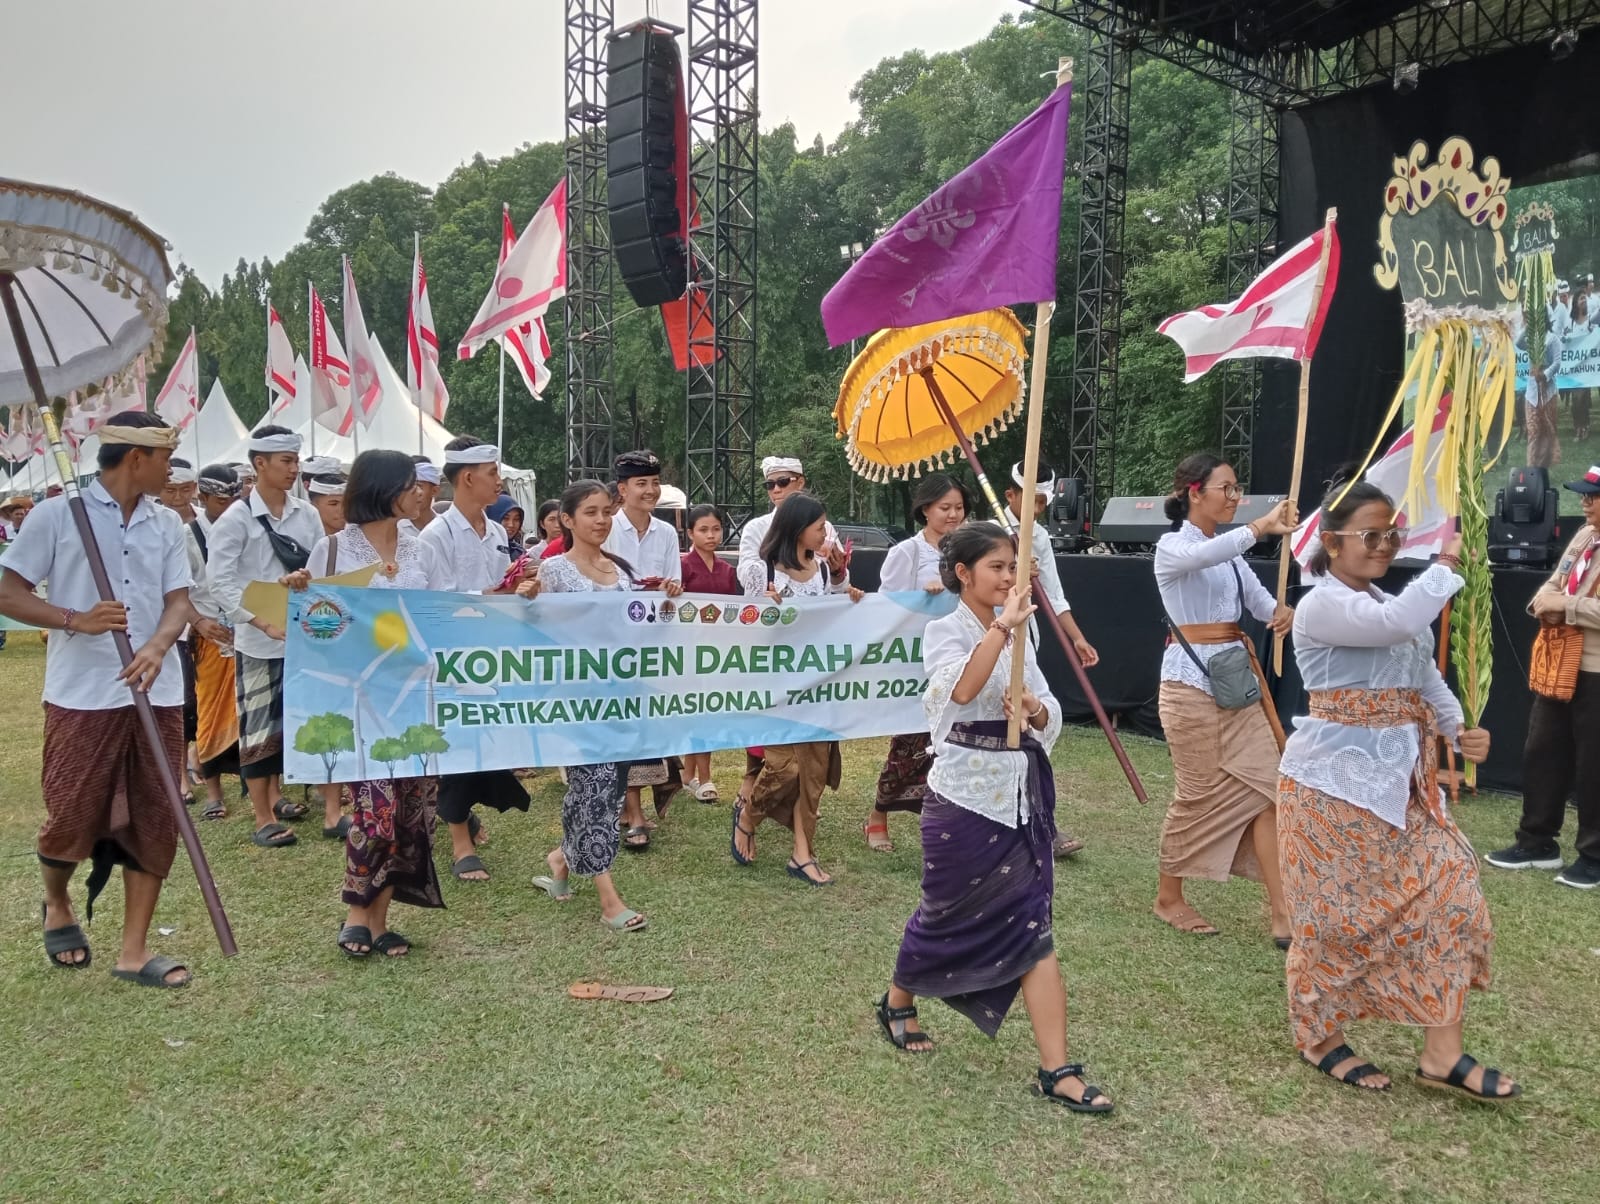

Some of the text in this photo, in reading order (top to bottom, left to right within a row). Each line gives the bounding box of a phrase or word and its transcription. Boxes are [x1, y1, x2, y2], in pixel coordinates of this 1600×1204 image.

[1523, 228, 1547, 249] BALI
[1411, 231, 1483, 298] BALI
[436, 637, 924, 684] KONTINGEN DAERAH BAL
[437, 698, 640, 727] PERTIKAWAN
[649, 690, 776, 717] NASIONAL
[787, 681, 869, 706] TAHUN
